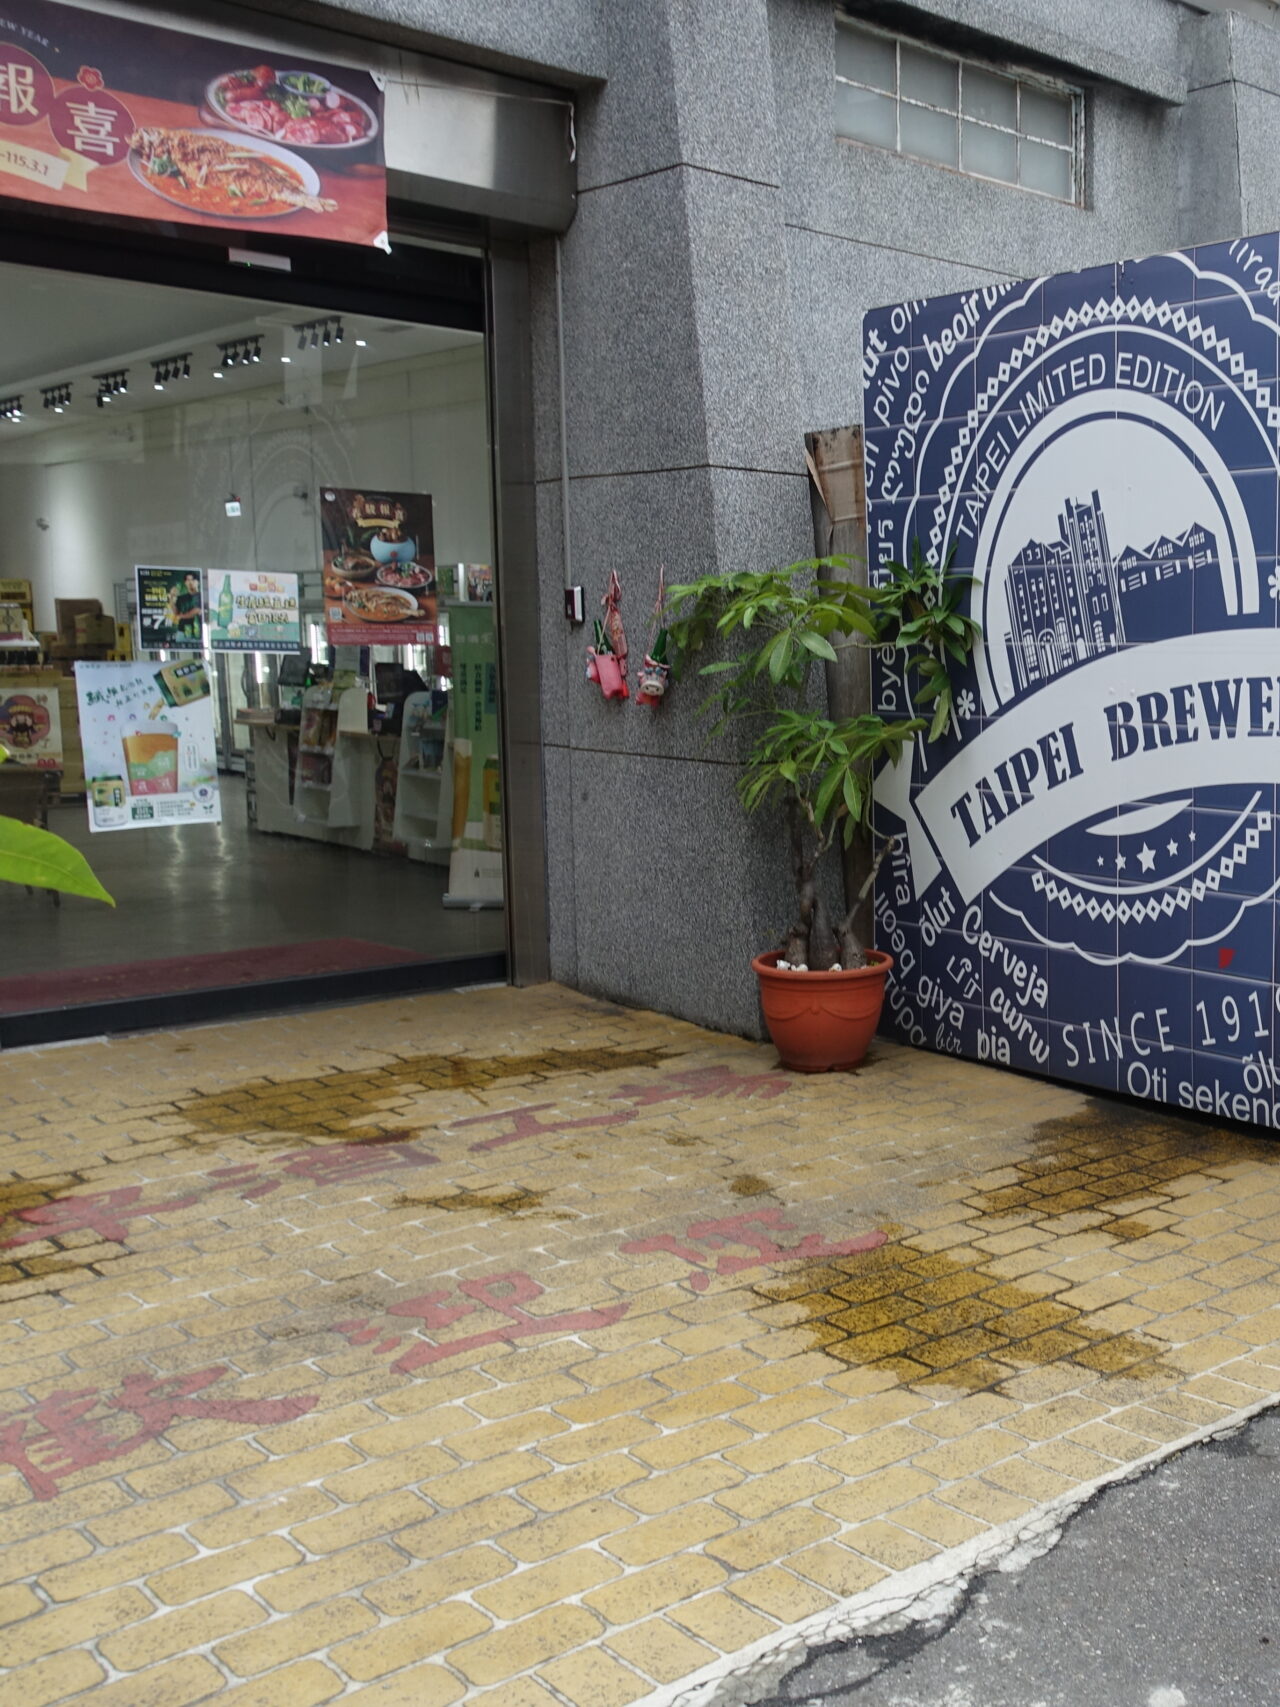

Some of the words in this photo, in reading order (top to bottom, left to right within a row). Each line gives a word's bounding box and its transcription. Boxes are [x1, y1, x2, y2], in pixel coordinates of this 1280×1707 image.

[922, 292, 980, 372] beoir
[873, 346, 909, 428] pivo
[956, 431, 1011, 539] TAIPEI
[1007, 353, 1106, 441] LIMITED
[1115, 352, 1225, 432] EDITION
[950, 722, 1084, 848] TAIPEI
[962, 905, 1048, 1008] Cerveja
[916, 975, 965, 1030] giya
[1062, 1008, 1174, 1067] SINCE
[1127, 1061, 1167, 1103] Oti
